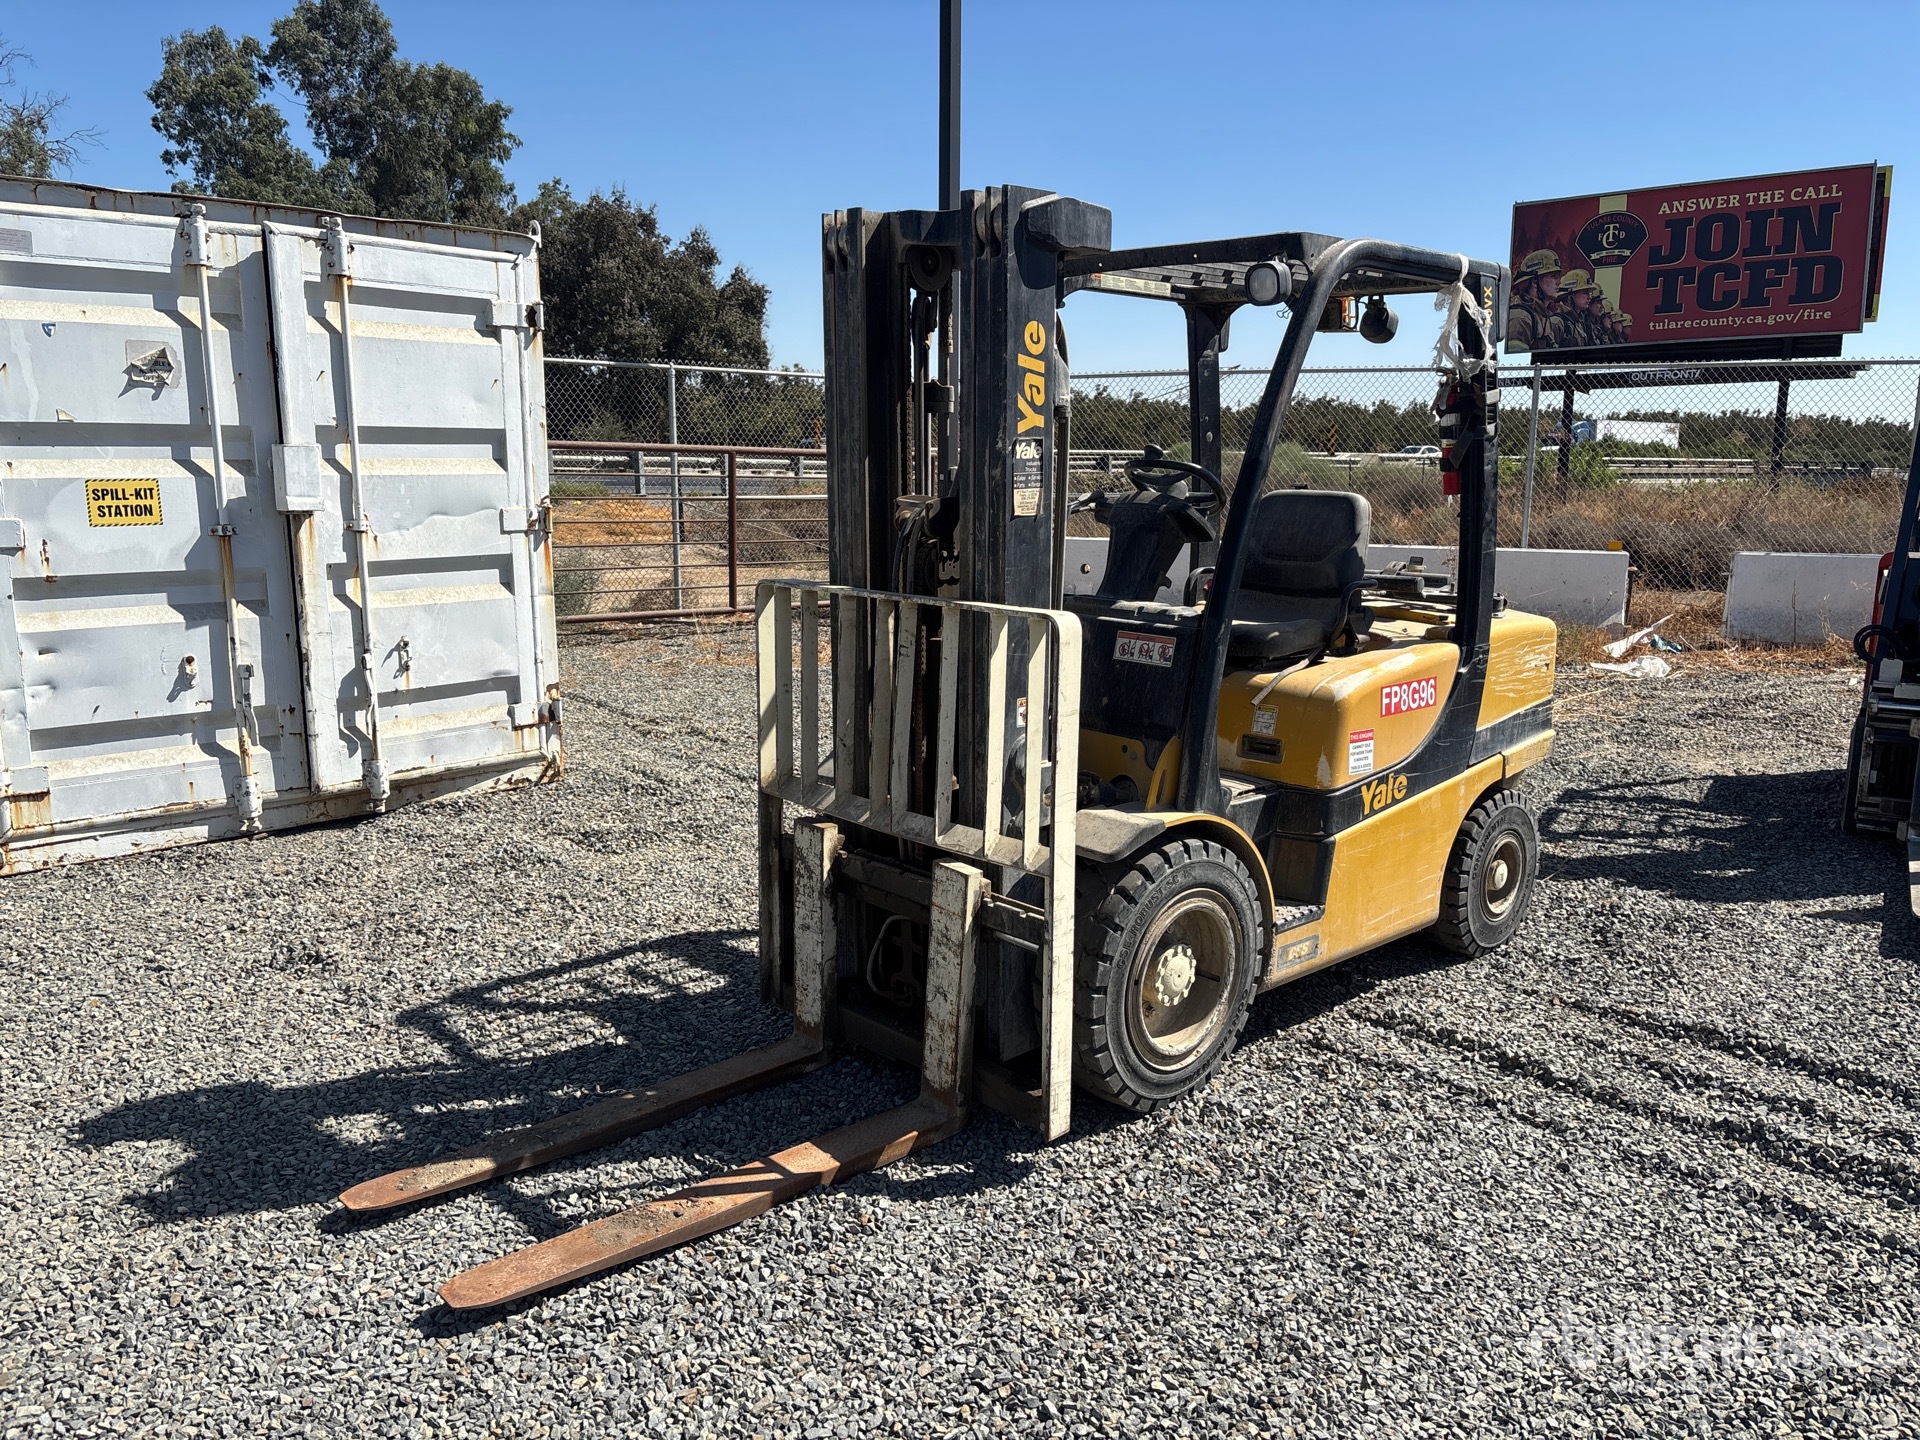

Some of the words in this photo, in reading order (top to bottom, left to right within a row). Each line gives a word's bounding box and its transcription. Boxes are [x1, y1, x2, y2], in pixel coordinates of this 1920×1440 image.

[1657, 194, 1741, 215] ANSWER
[1745, 189, 1785, 205] THE
[1790, 184, 1843, 201] CALL
[1647, 202, 1843, 267] JOIN
[1646, 255, 1845, 316] TCFD
[1649, 309, 1832, 331] tularecounty.ca.gov/fire
[1017, 320, 1046, 435] Yale
[1015, 441, 1043, 460] Yale
[91, 487, 155, 501] SPILL-KIT
[97, 503, 154, 518] STATION
[1381, 678, 1436, 716] FP8G96
[1361, 773, 1408, 815] Yale
[1129, 887, 1164, 936] ROBUST
